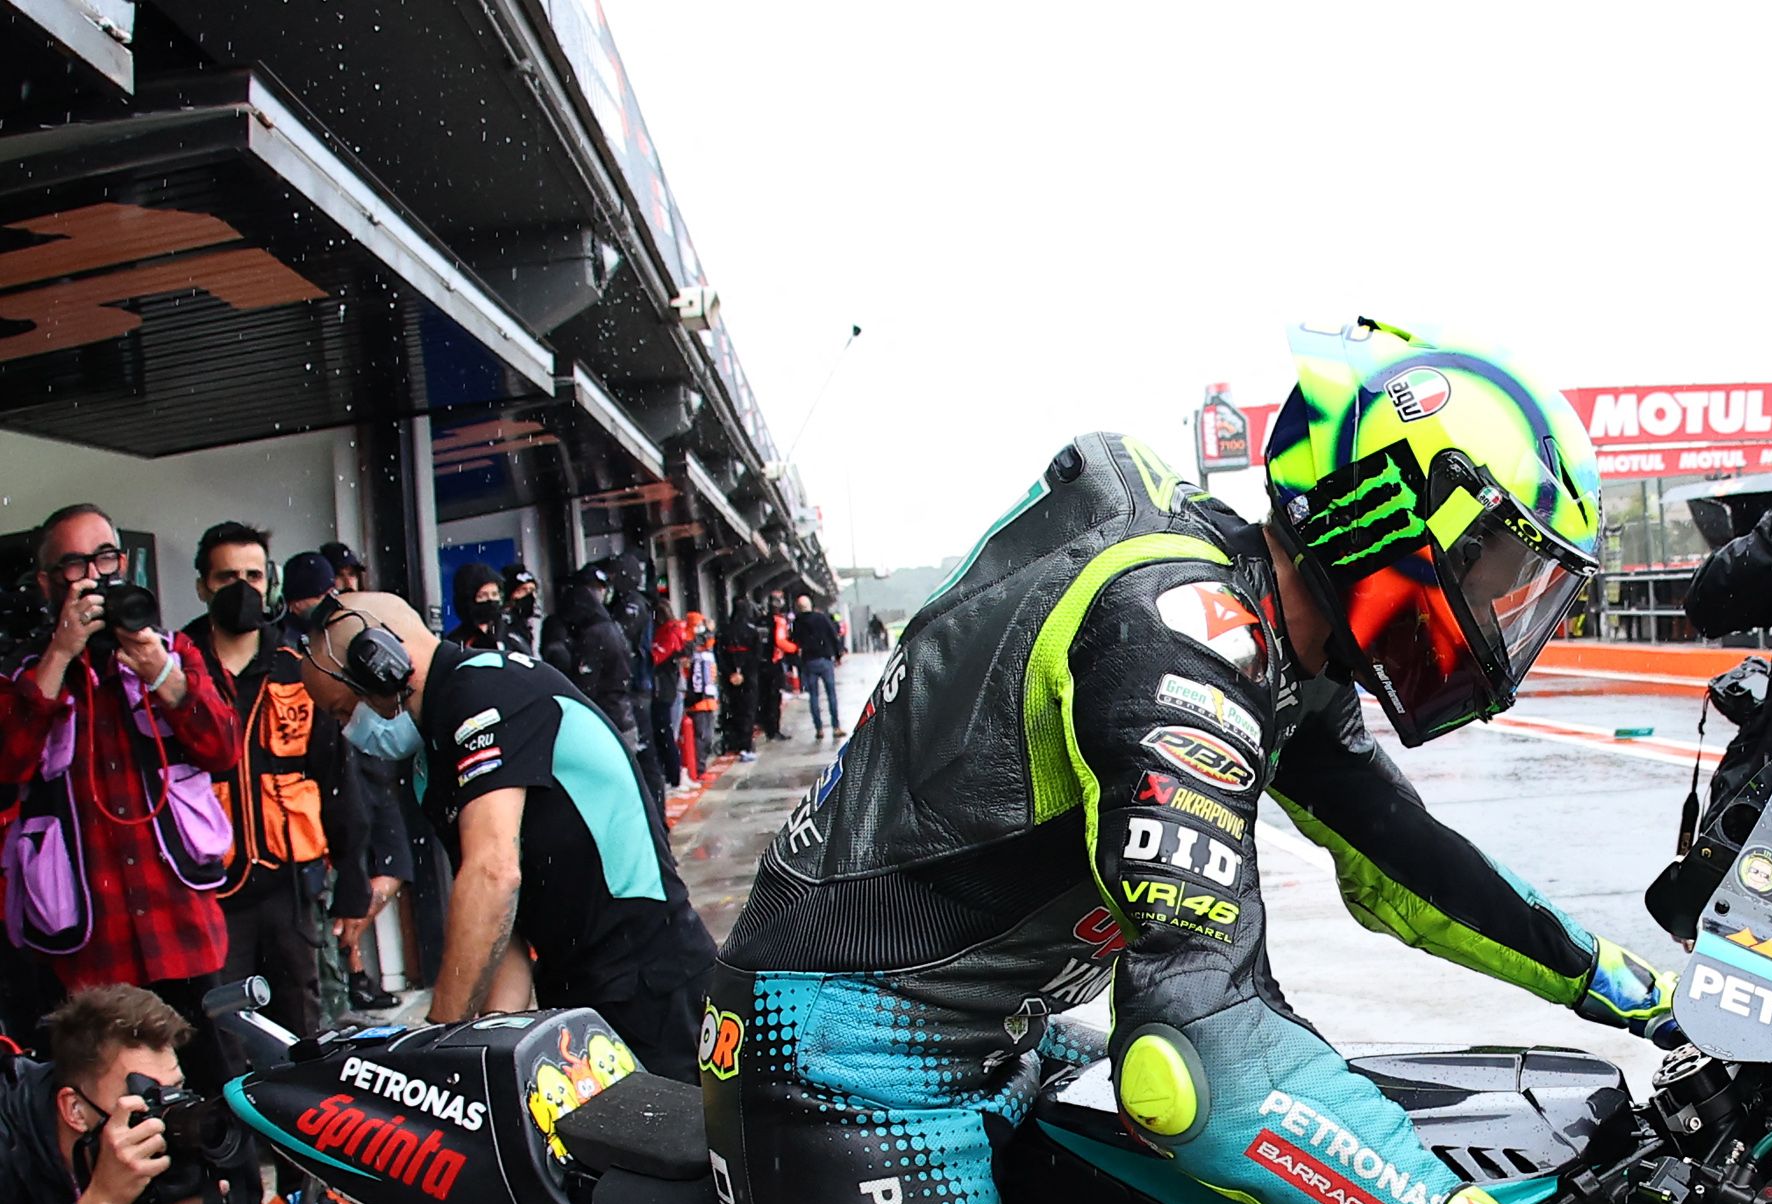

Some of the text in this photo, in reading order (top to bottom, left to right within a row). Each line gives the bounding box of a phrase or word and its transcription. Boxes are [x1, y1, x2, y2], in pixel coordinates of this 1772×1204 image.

[1391, 381, 1421, 416] agv
[1589, 389, 1772, 437] MOTUL
[1600, 453, 1665, 473] MOTUL
[1679, 450, 1746, 469] MOTUL
[1166, 679, 1207, 704] Green
[1227, 707, 1258, 738] Power
[1151, 730, 1253, 787] PBR
[1170, 918, 1232, 944] APPAREL
[340, 1057, 486, 1131] PETRONAS
[296, 1094, 467, 1201] Sprinta
